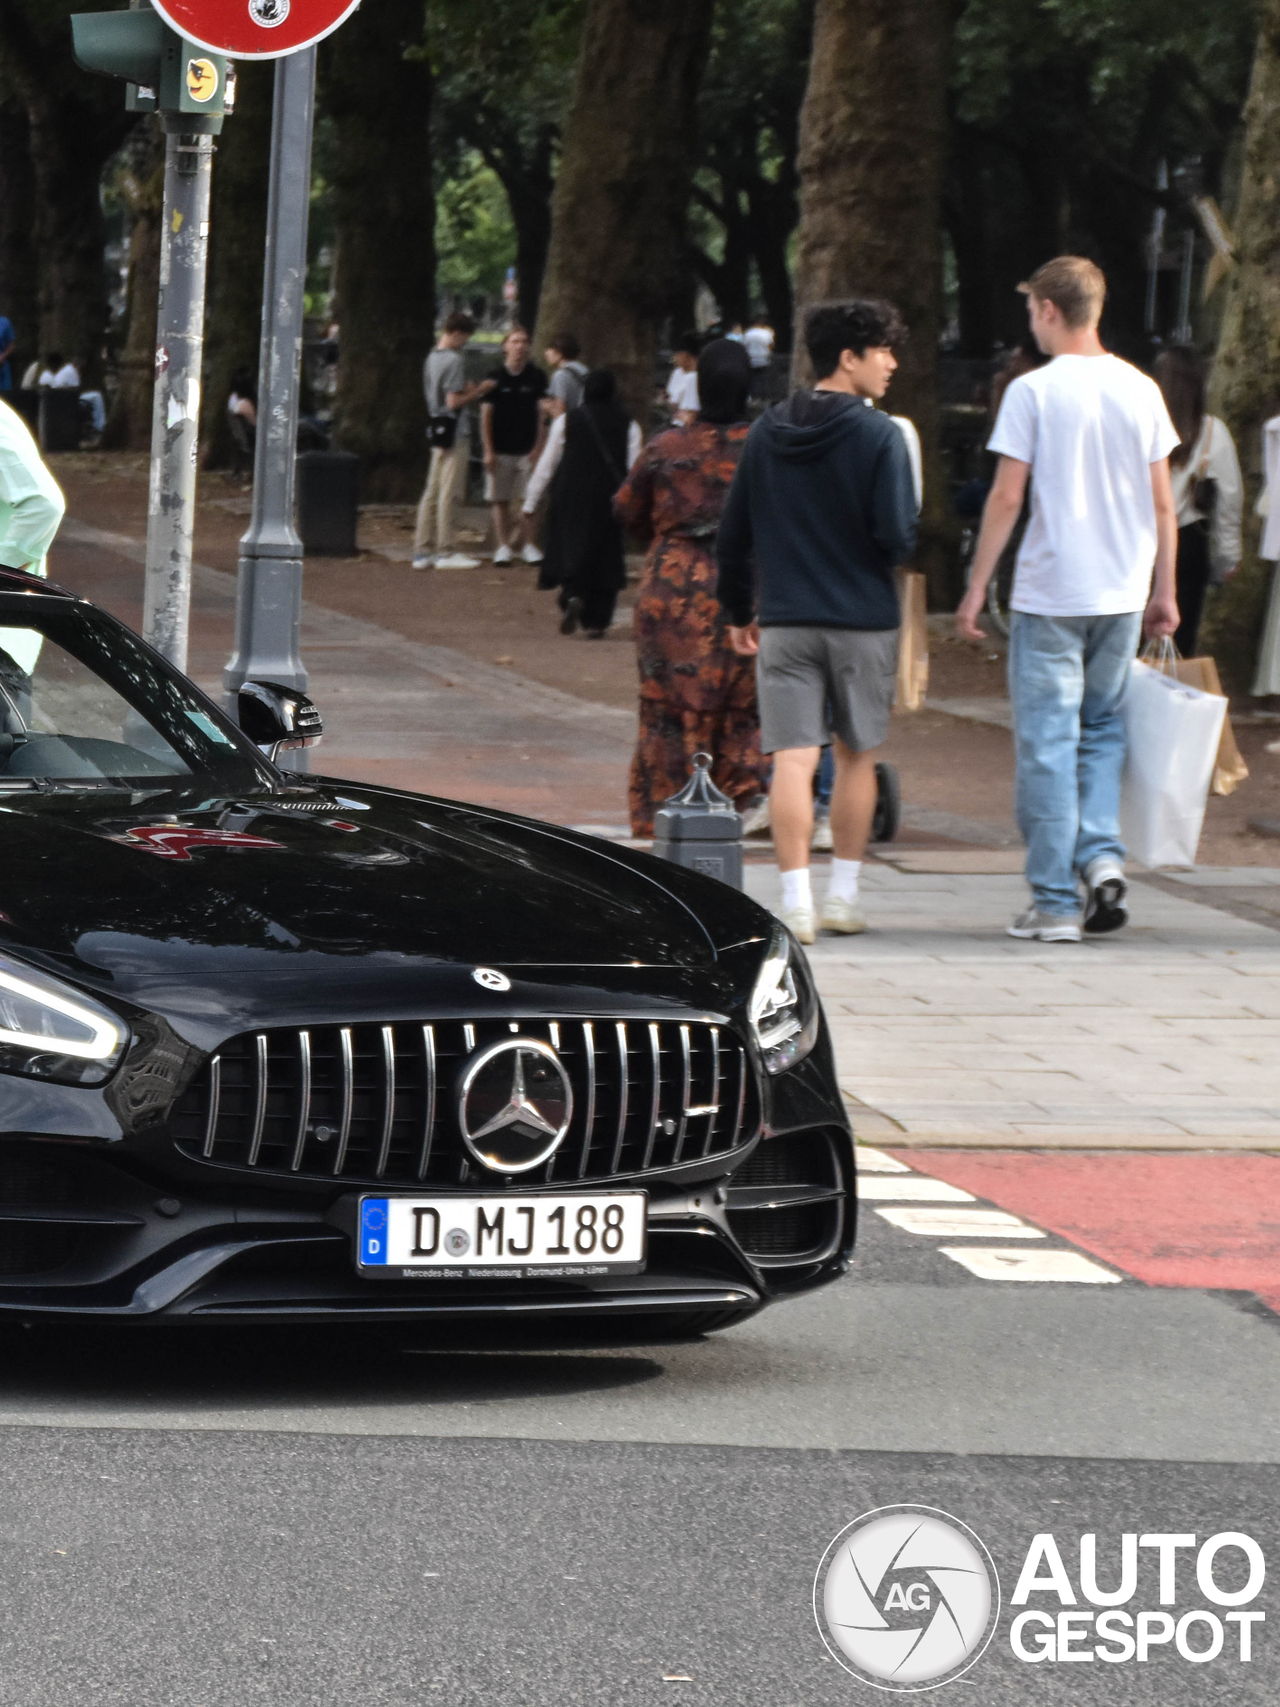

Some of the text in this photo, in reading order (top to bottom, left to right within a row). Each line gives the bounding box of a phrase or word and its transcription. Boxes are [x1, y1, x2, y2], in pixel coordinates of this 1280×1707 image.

[411, 1203, 625, 1257] D MJ 188
[368, 1239, 380, 1255] D
[402, 1268, 464, 1278] Mercedes-Benz
[468, 1267, 523, 1279] Niederlassung
